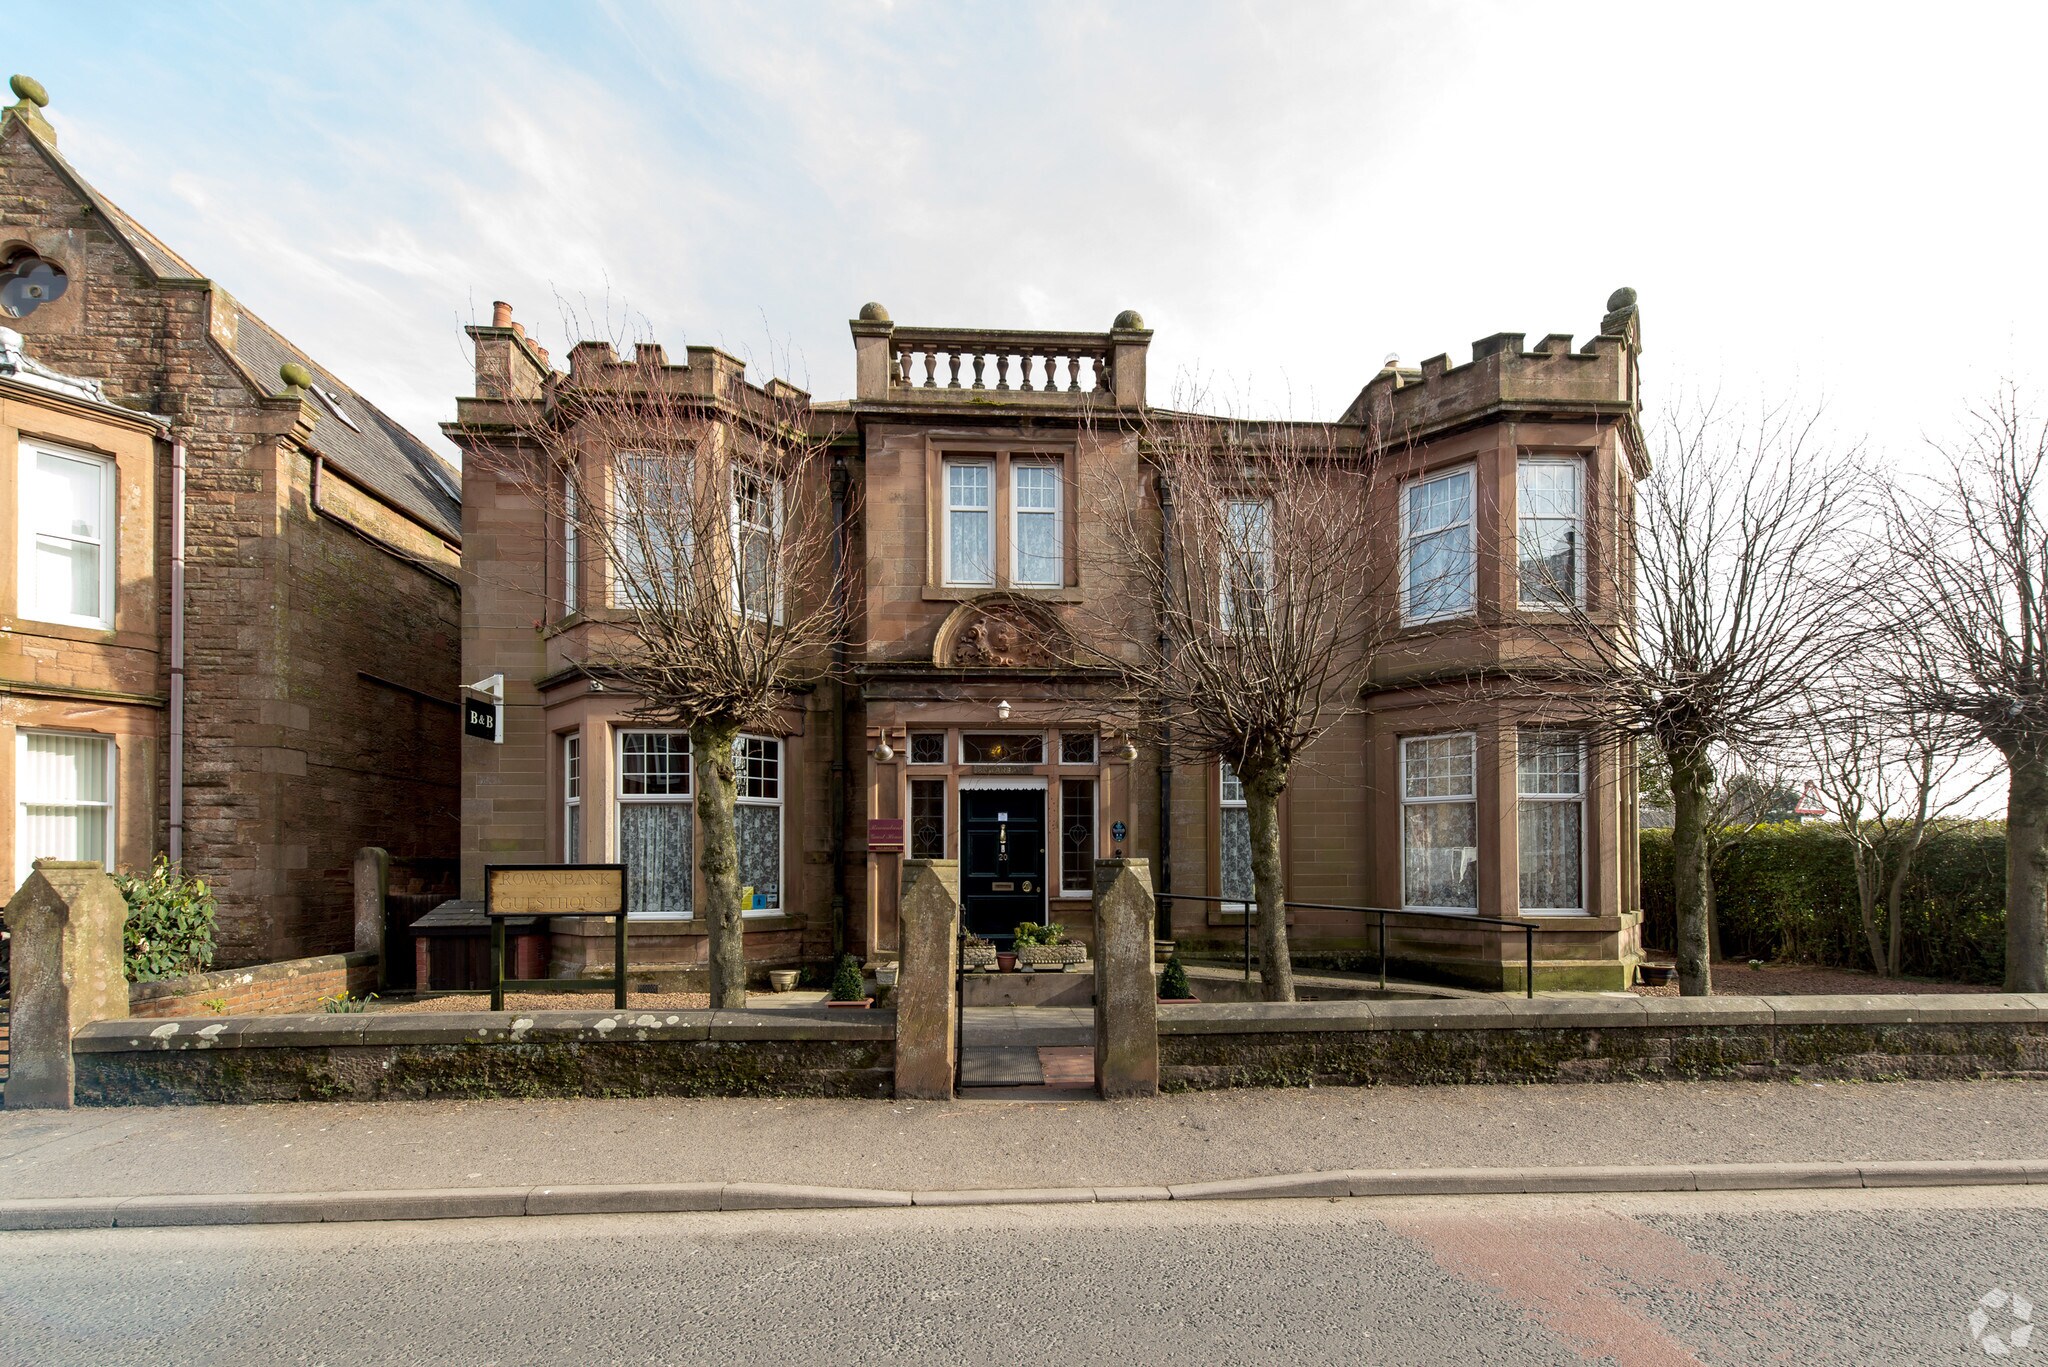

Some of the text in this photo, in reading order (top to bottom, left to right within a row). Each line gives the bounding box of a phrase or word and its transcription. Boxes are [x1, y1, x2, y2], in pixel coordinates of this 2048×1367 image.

[470, 710, 493, 728] B&B
[998, 853, 1008, 861] 20
[500, 873, 610, 885] ROWANBANK
[500, 896, 614, 910] GUESTHOUSE
